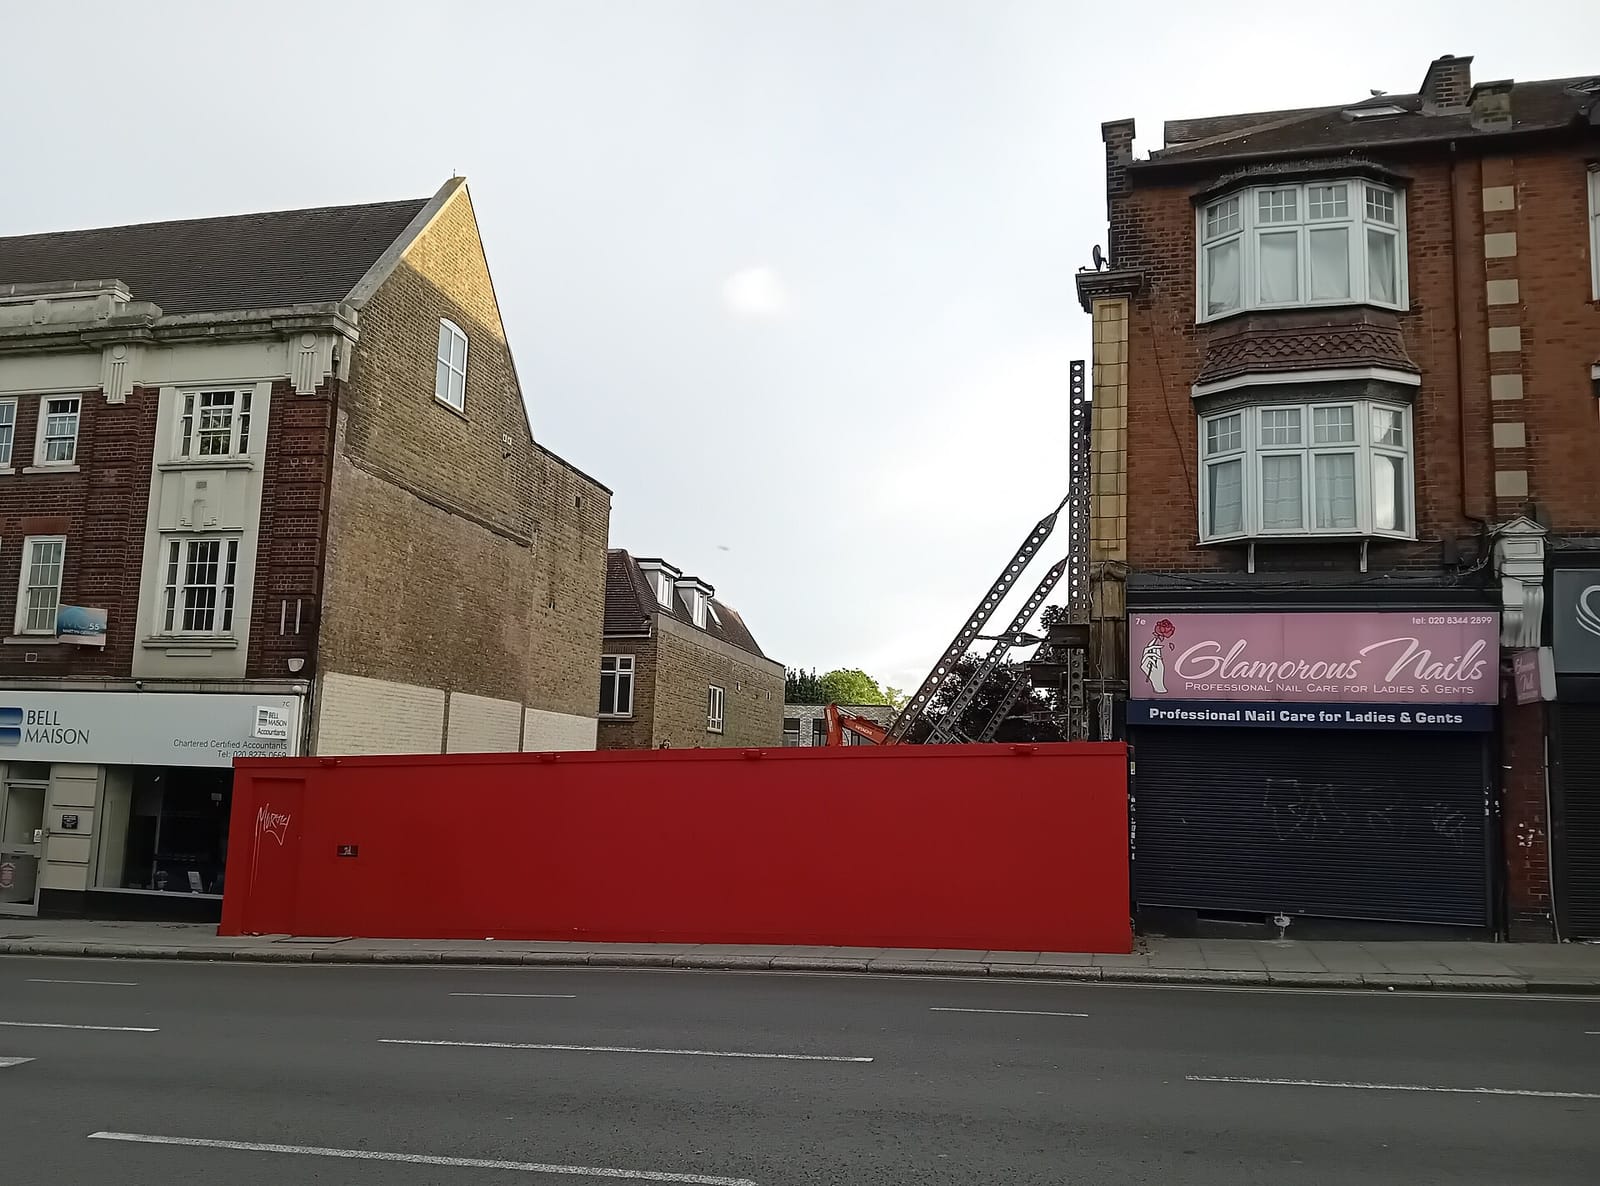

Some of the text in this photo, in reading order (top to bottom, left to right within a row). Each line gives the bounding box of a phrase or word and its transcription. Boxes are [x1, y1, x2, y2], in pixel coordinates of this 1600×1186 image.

[1135, 617, 1146, 626] 7e
[1428, 616, 1445, 625] 020
[1446, 616, 1468, 625] 8344
[1174, 639, 1362, 683] Glamorous
[1359, 637, 1488, 682] Nails
[1185, 681, 1475, 695] PROFESSIONAL NAIL CARE FOR LADIES & GENTS
[26, 709, 61, 726] BELL
[268, 711, 280, 720] BELL
[1149, 707, 1463, 724] Professional Nail Care for Ladies & Gents
[267, 719, 288, 728] MAISON
[24, 728, 90, 745] MAISON
[256, 727, 287, 737] Accountants
[173, 739, 288, 750] Chartered Certified Accountants
[217, 750, 231, 759] Tel:
